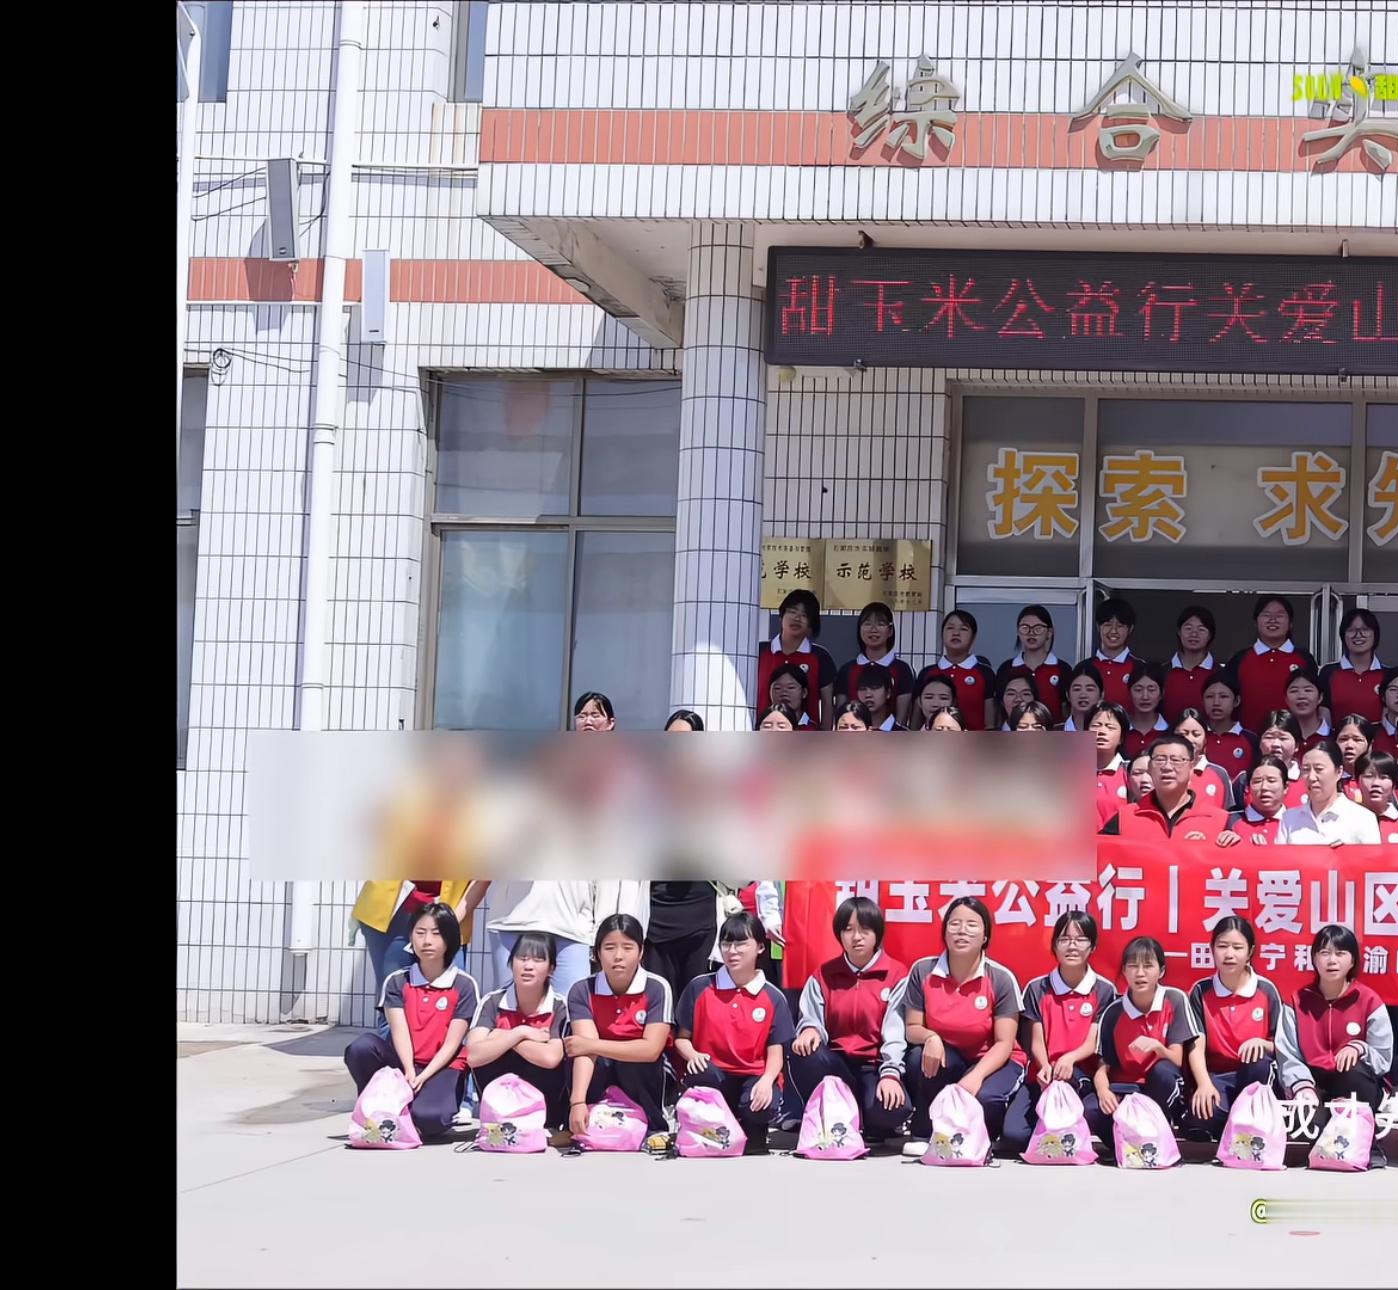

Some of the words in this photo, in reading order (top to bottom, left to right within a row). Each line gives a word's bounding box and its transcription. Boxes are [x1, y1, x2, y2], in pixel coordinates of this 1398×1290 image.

[988, 447, 1187, 543] 探索
[836, 562, 918, 581] 示范学校
